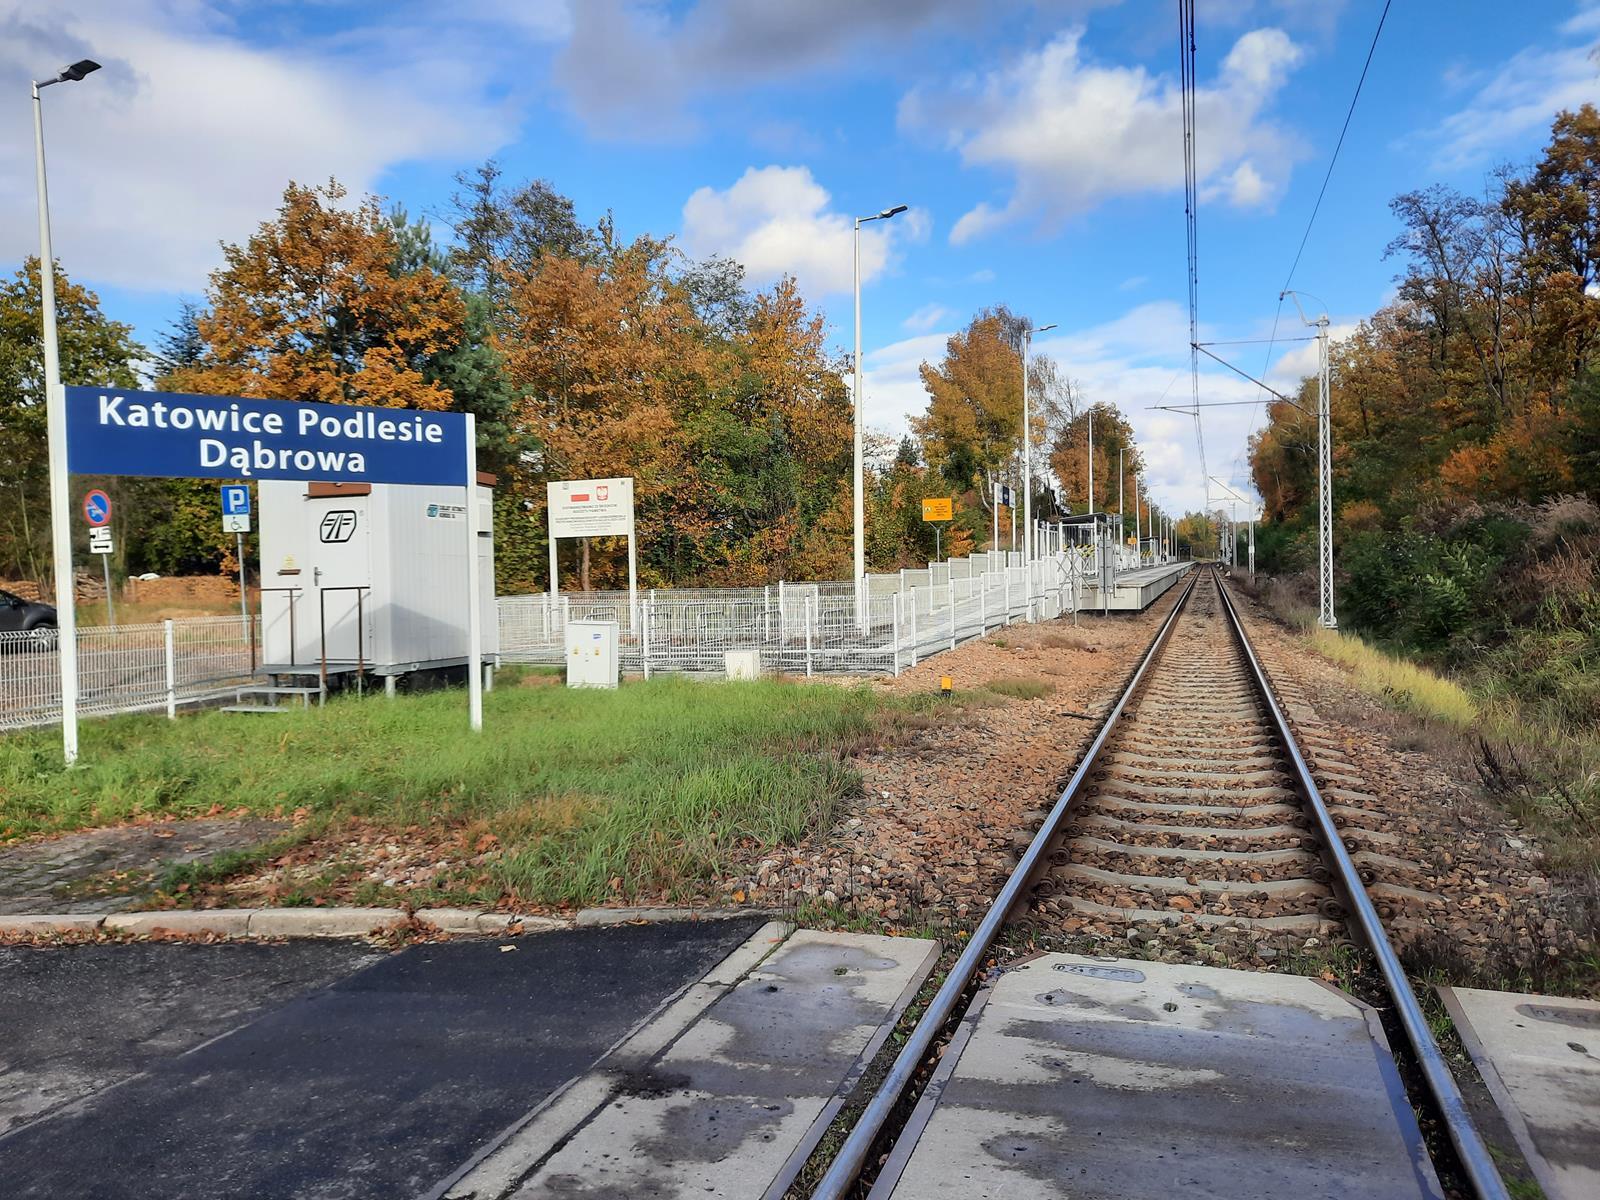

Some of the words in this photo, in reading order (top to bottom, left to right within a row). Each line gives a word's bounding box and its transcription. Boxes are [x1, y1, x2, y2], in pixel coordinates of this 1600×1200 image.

[98, 395, 284, 435] Katowice
[298, 402, 443, 443] Podlesie
[200, 438, 366, 477] Dąbrowa
[228, 489, 245, 512] P
